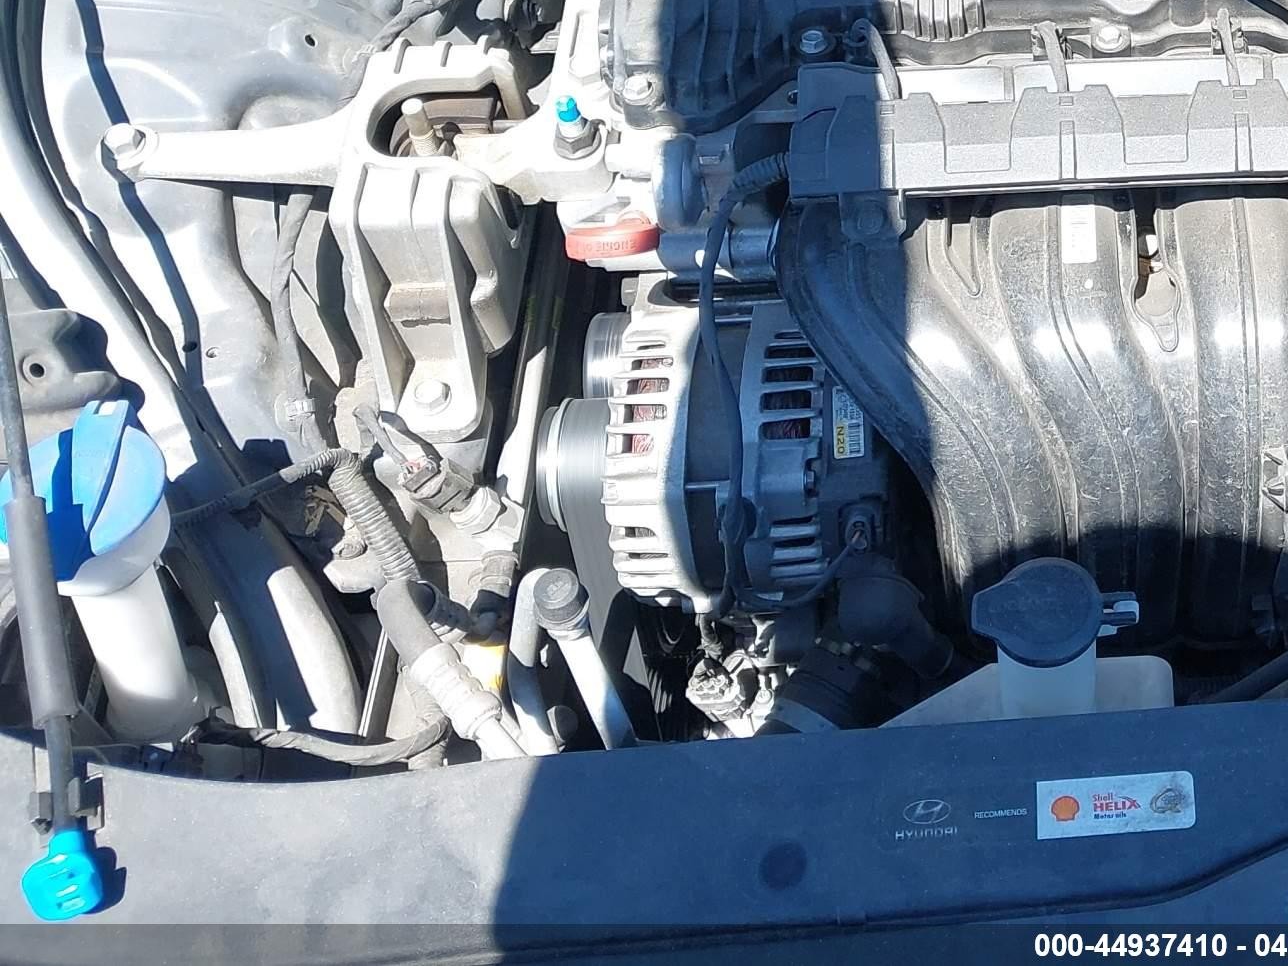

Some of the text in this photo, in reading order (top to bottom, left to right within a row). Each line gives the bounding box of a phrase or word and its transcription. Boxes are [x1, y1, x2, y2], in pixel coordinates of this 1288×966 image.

[835, 425, 845, 455] N20
[1092, 792, 1113, 802] Shell
[1093, 799, 1139, 812] HELIX
[974, 808, 1028, 820] RECOMMENDS
